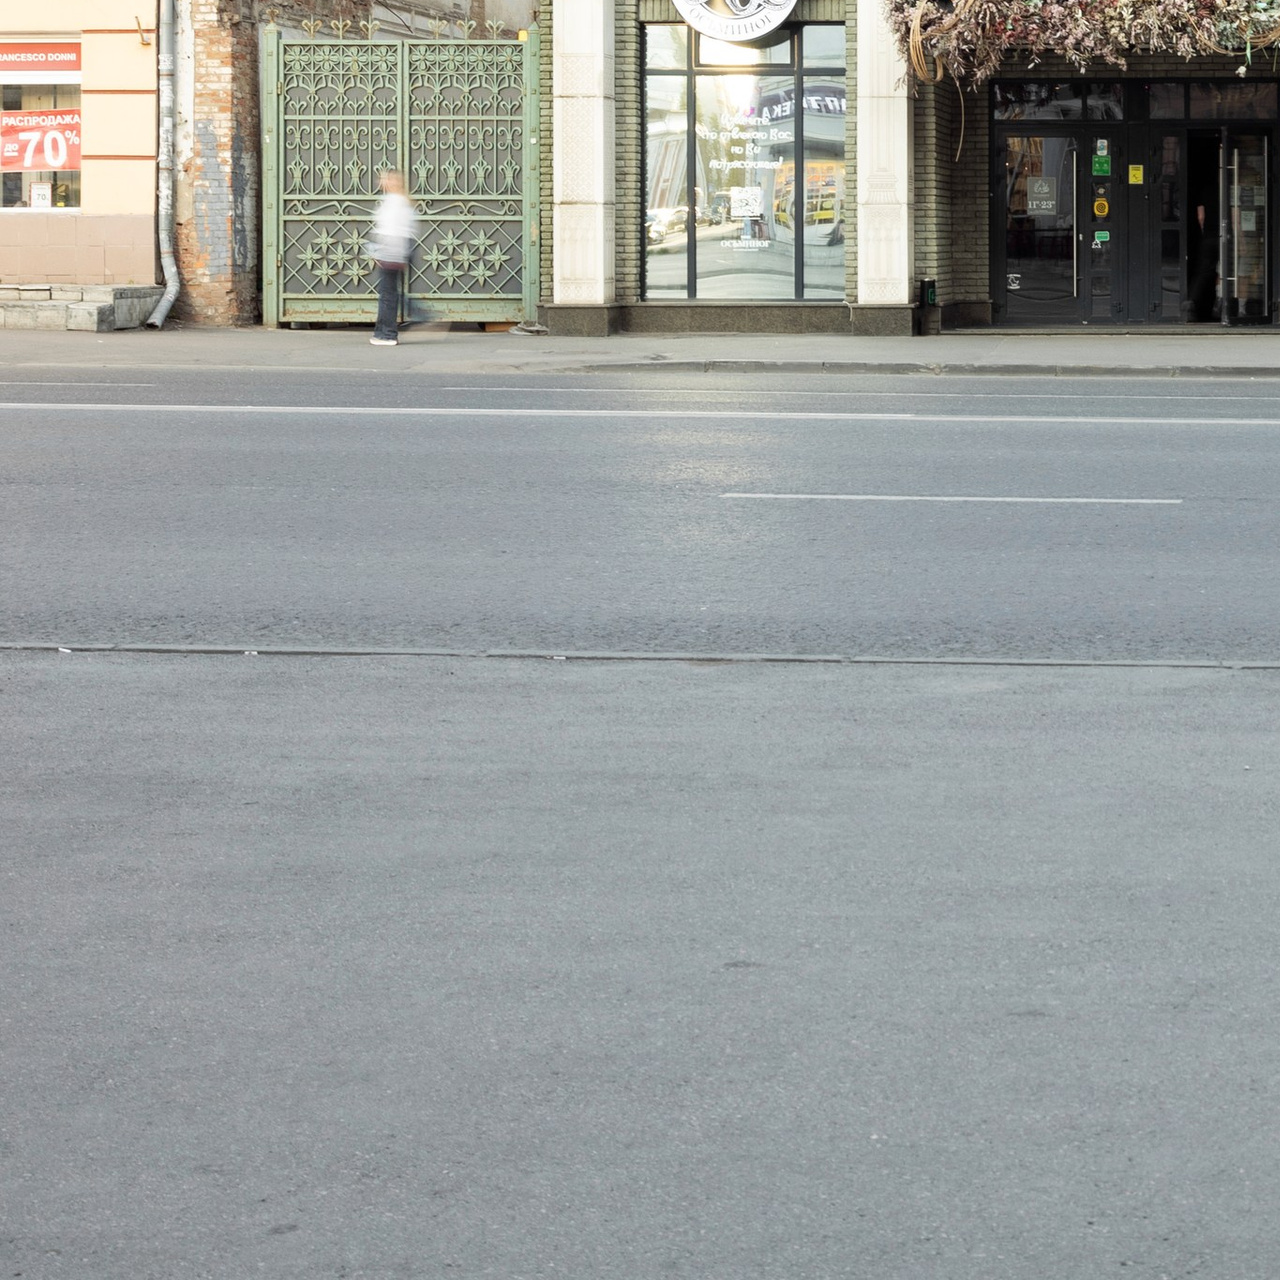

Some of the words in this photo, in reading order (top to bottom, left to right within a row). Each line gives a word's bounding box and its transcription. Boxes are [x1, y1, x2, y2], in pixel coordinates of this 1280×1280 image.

[47, 52, 77, 62] DONNI
[2, 113, 81, 127] РАСПРОДАЖА
[4, 143, 19, 153] до
[18, 129, 80, 168] 70%
